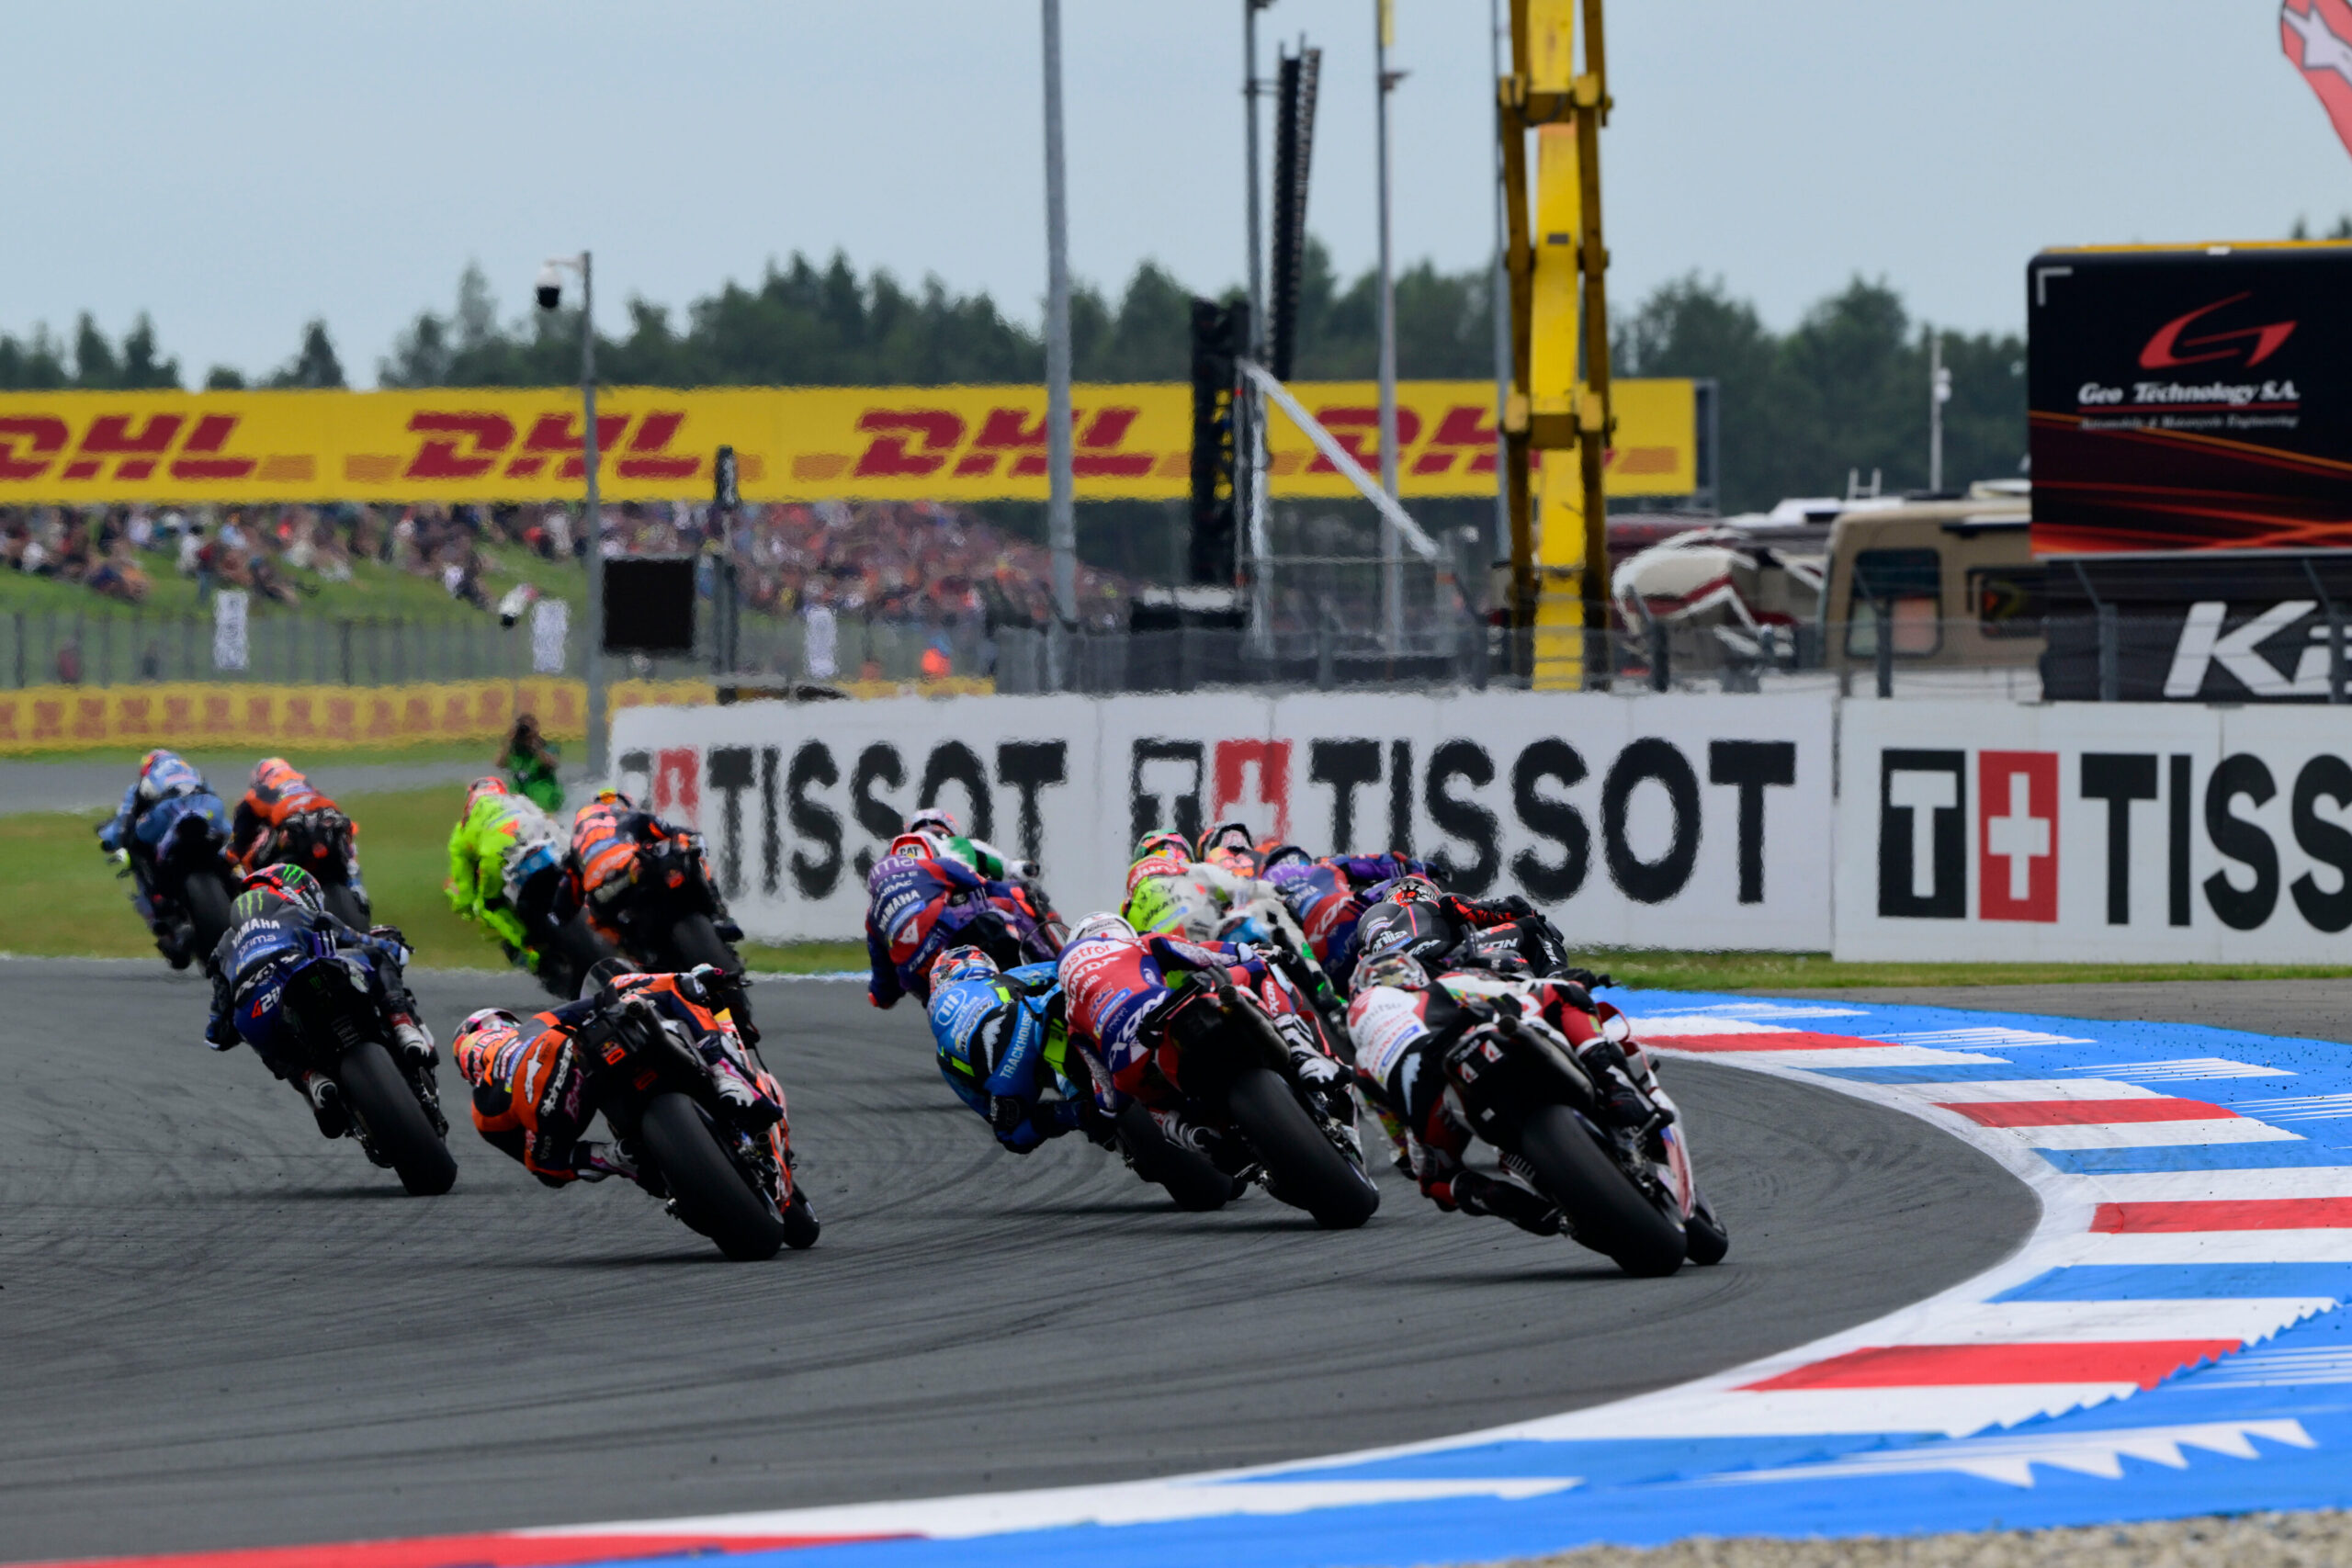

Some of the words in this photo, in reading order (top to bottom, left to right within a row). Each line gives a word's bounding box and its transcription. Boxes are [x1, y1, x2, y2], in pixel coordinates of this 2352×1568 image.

[2078, 382, 2123, 404] Geo
[2132, 380, 2258, 406] Technology
[0, 412, 258, 481] DHL
[402, 412, 701, 480] DHL
[854, 407, 1156, 479] DHL
[1306, 406, 1614, 475] DH
[707, 739, 1067, 899] TISSOT
[899, 846, 919, 857] CAT
[1309, 736, 1796, 905] TISSOT
[2080, 751, 2352, 933] TISS
[232, 919, 280, 949] YAMAHA
[239, 934, 277, 960] prima
